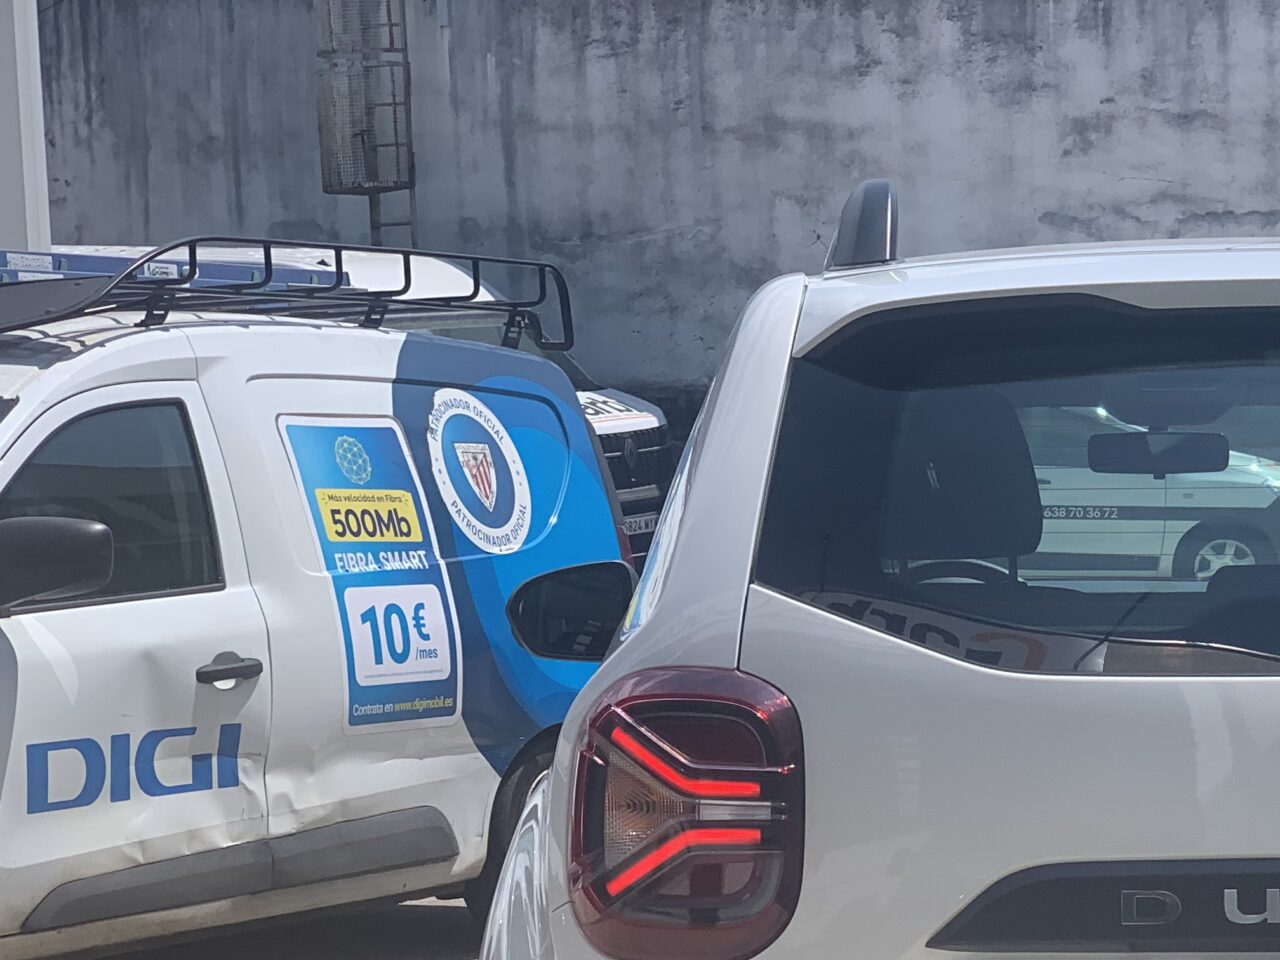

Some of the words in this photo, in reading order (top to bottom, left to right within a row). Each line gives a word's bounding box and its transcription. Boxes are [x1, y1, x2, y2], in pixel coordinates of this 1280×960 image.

[431, 398, 471, 442] PATROCINADOR
[472, 407, 504, 445] OFICIAL
[343, 494, 376, 503] velocidad
[385, 494, 402, 503] Fibra
[330, 507, 412, 538] 500Mb
[451, 500, 513, 547] PATROCINADOR
[511, 503, 527, 540] OFICIAL
[1043, 507, 1066, 518] 638
[1068, 507, 1084, 518] 70
[1086, 507, 1101, 518] 36
[1103, 507, 1118, 519] 72
[334, 551, 377, 574] FIBRA
[378, 550, 430, 571] SMART
[352, 703, 383, 717] Contrata
[384, 705, 394, 713] en
[393, 696, 454, 713] www.digimobil.es
[26, 722, 243, 815] DIGI
